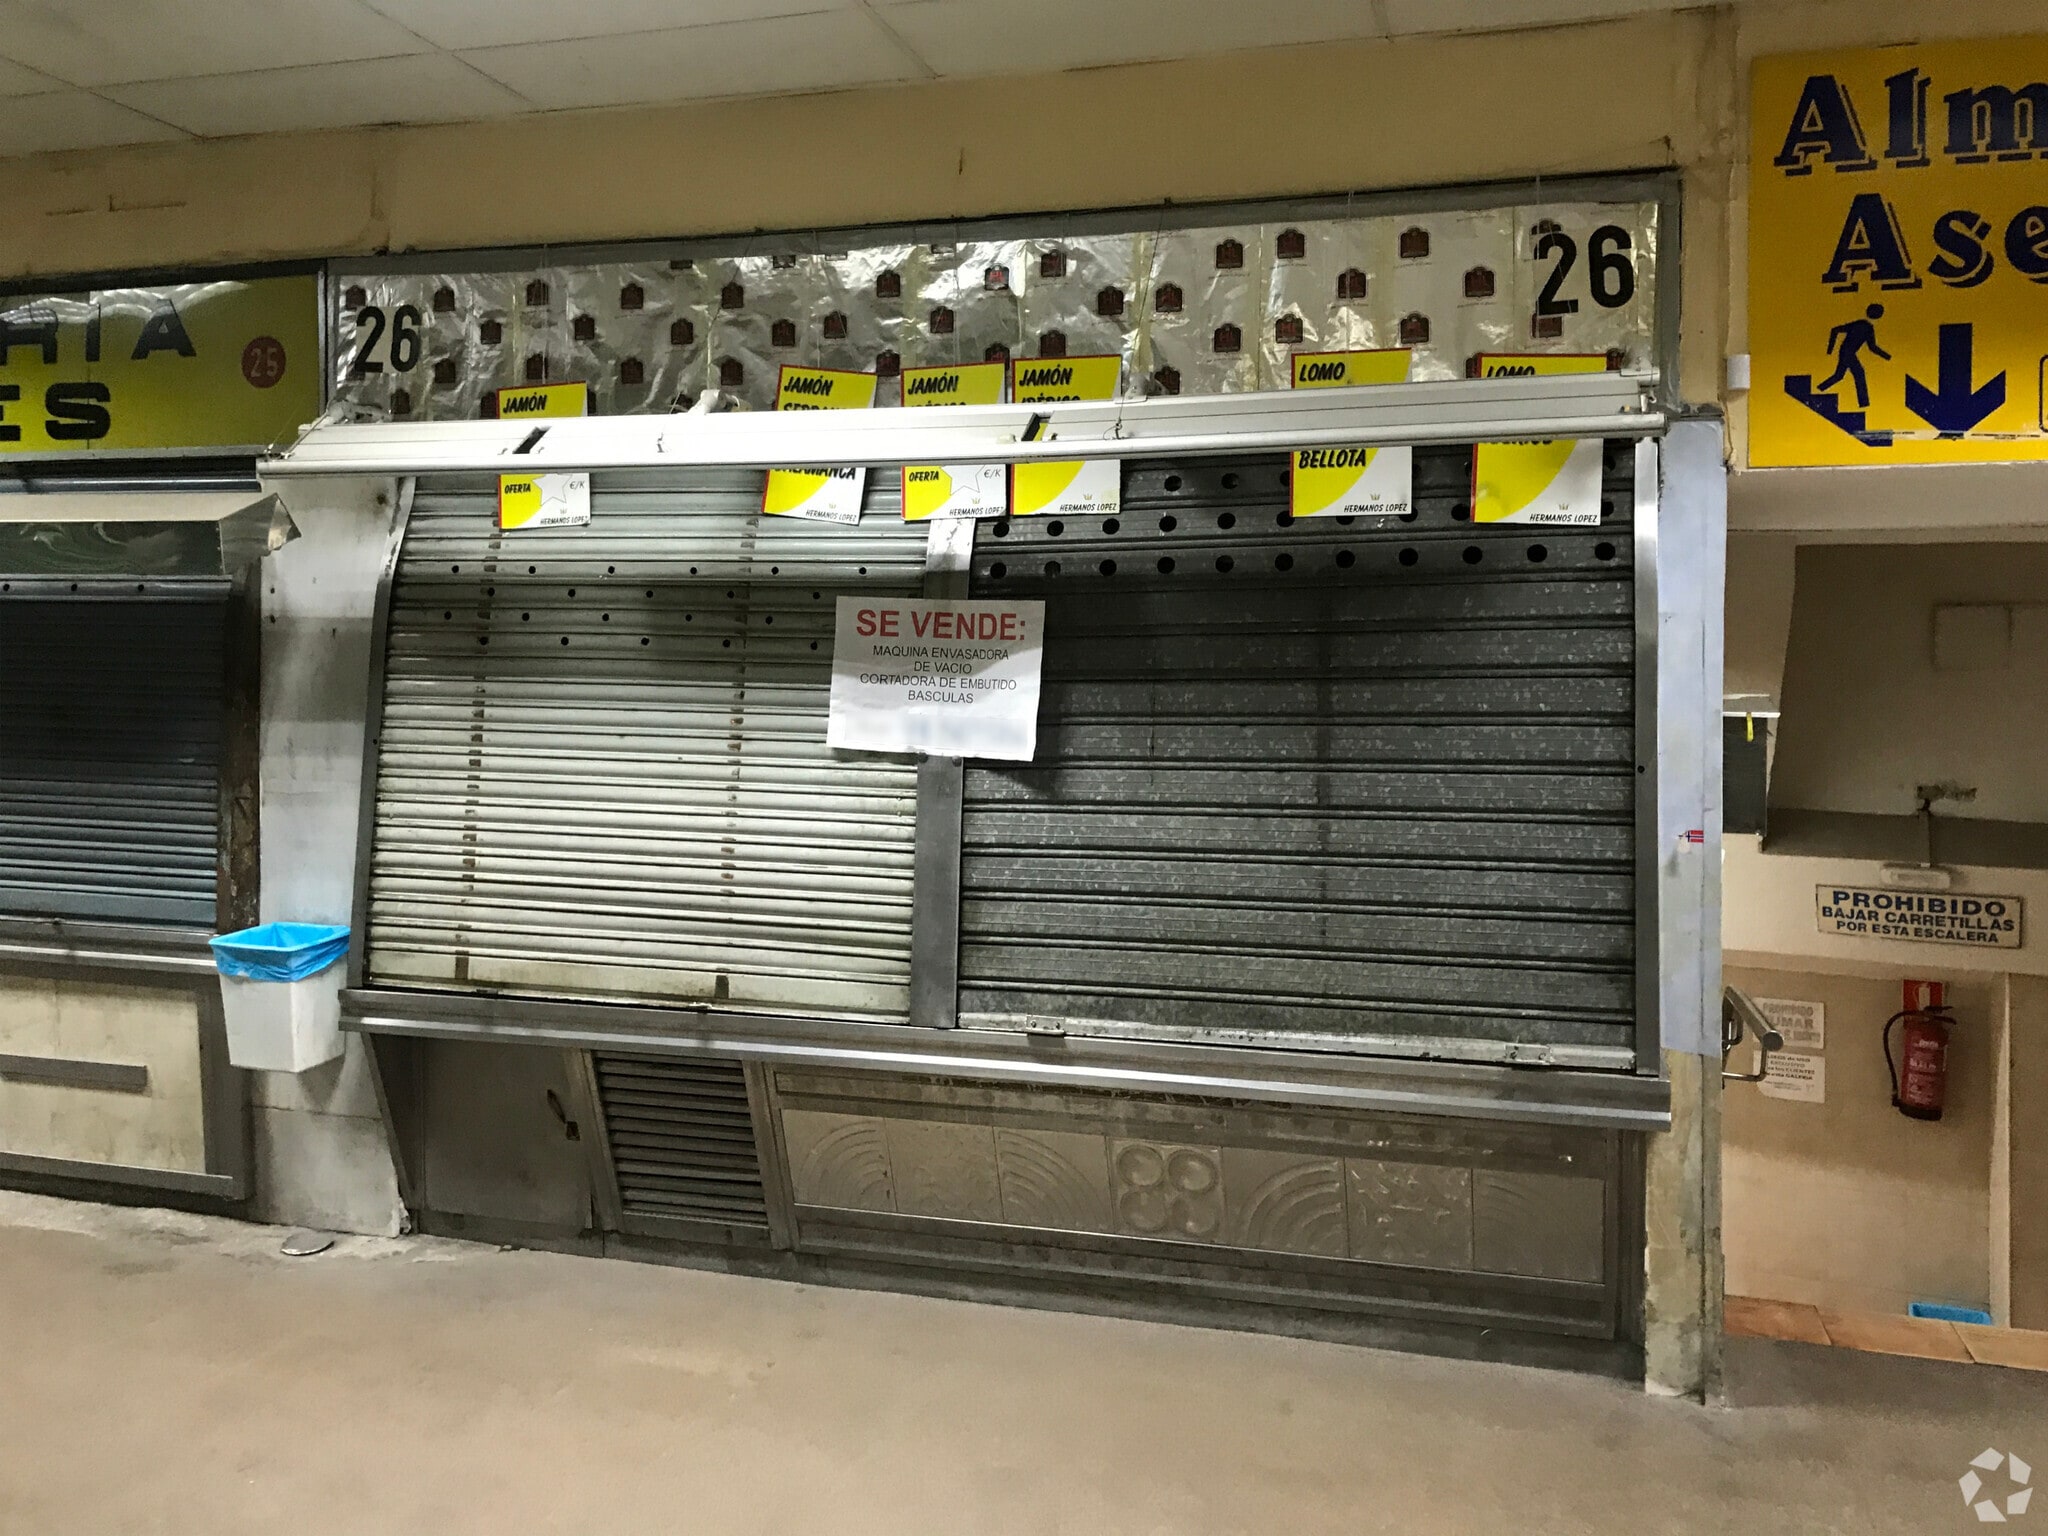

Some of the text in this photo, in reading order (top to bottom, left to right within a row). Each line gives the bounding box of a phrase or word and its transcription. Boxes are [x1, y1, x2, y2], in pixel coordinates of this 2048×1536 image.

[1534, 224, 1634, 316] 26
[354, 304, 422, 373] 26
[249, 346, 279, 378] 25
[1299, 362, 1346, 382] LOMO
[907, 371, 959, 395] JAMÓN
[1018, 363, 1073, 387] JAMÓN
[784, 375, 834, 396] JAMÓN
[502, 391, 548, 414] JAMÓN
[1299, 448, 1367, 469] BELLOTA
[909, 470, 940, 482] OFERTA
[504, 483, 532, 494] OFERTA
[806, 509, 837, 520] HERMANOS
[949, 507, 984, 516] HERMANOS
[1059, 502, 1117, 512] HERMANOS LOPEZ
[1343, 503, 1408, 513] HERMANOS LOPEZ
[539, 516, 570, 525] HERMANOS
[1529, 513, 1598, 523] HERMANOS LOPEZ
[856, 609, 1026, 641] SE VENDE:
[873, 645, 1009, 660] MAQUINA ENVASADORA
[914, 661, 972, 674] DE VACIO
[860, 673, 1017, 691] CORTADORA DE EMBUTIDO
[908, 690, 974, 704] BASCULAS
[1832, 890, 2007, 917] PROHIBIDO
[1822, 906, 2015, 931] BAJAR CARRETILLAS
[1836, 921, 1998, 943] POR ESTA ESCALERA
